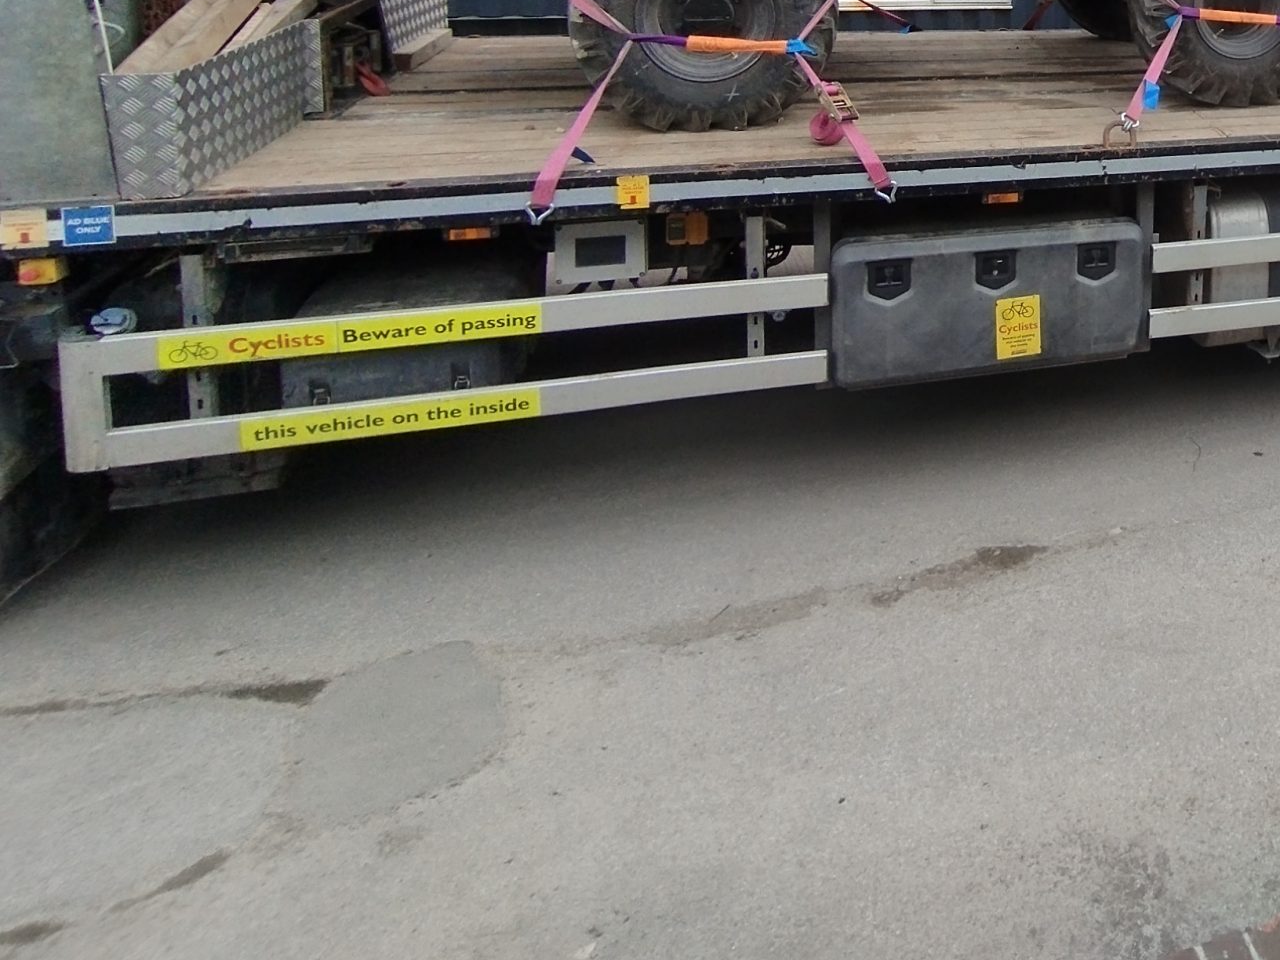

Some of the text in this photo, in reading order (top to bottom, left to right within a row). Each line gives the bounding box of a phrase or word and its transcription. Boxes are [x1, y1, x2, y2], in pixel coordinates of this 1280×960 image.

[75, 226, 101, 234] ONLY
[228, 313, 537, 357] Cyclists Beware of passing
[999, 322, 1038, 335] Cyclists
[254, 397, 530, 442] this vehicle on the inside
